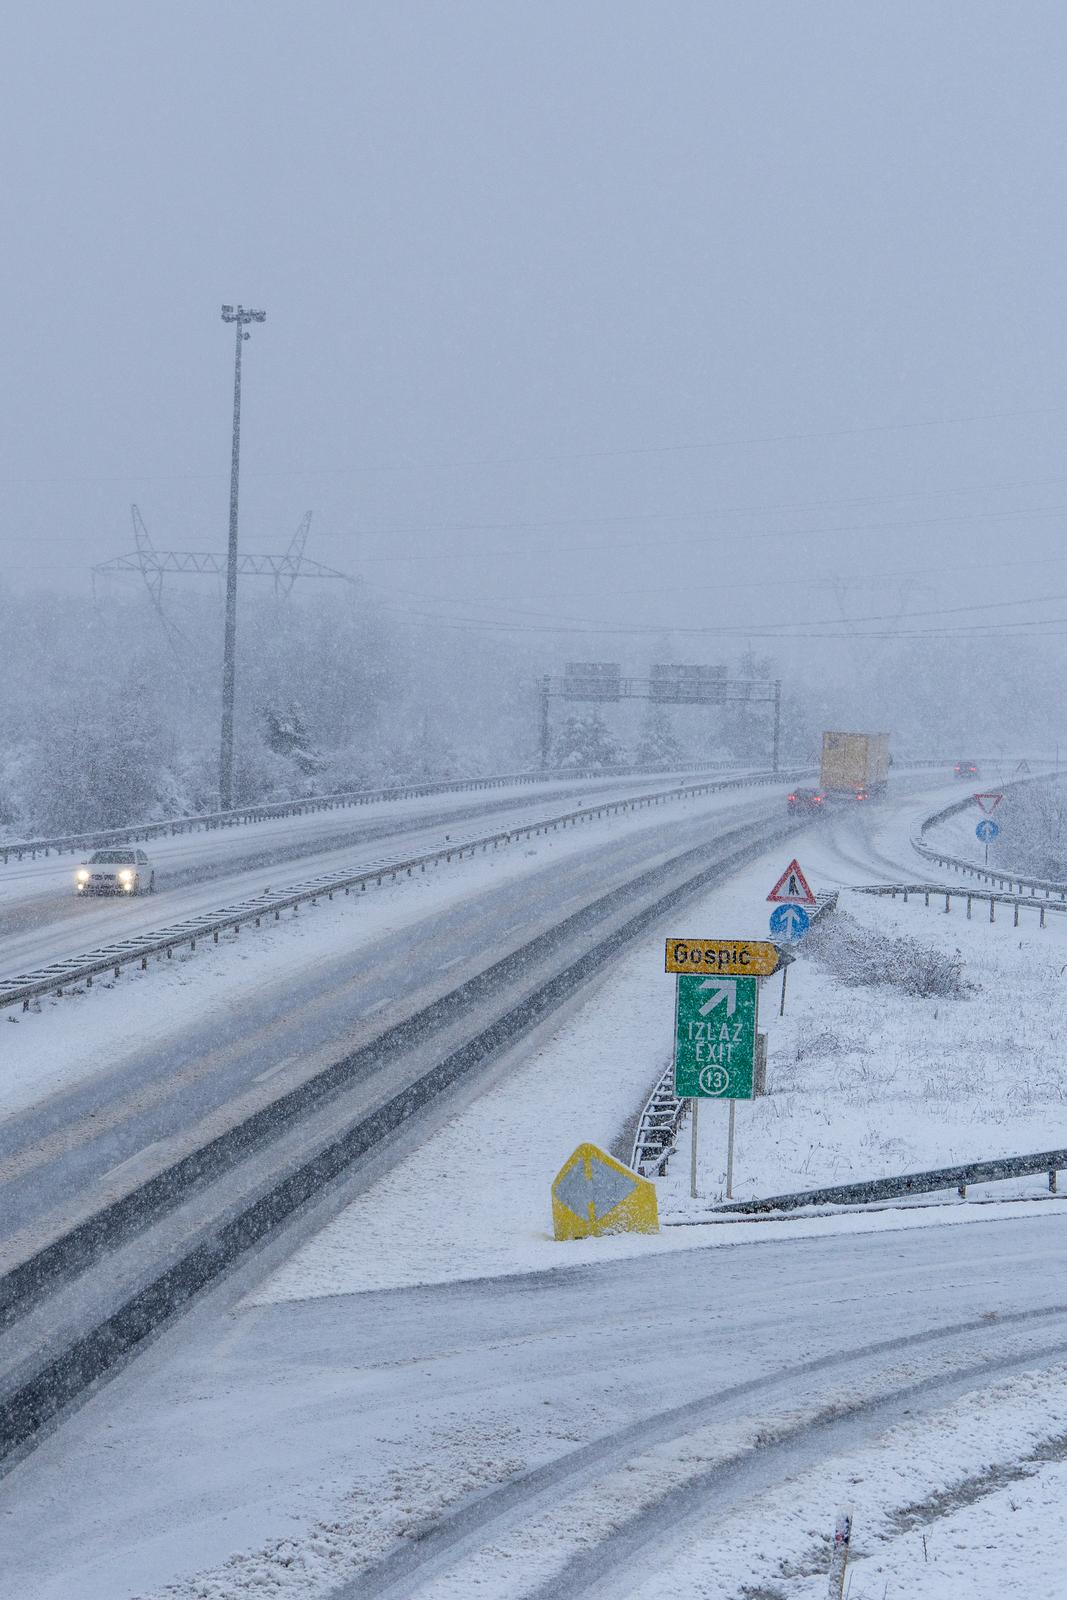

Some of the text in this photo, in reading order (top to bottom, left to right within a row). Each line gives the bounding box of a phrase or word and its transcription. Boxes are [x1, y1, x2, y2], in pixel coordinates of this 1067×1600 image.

[673, 943, 751, 969] Gospić
[688, 1021, 743, 1042] IZLAZ
[695, 1042, 733, 1063] EXIT
[706, 1072, 722, 1088] 13
